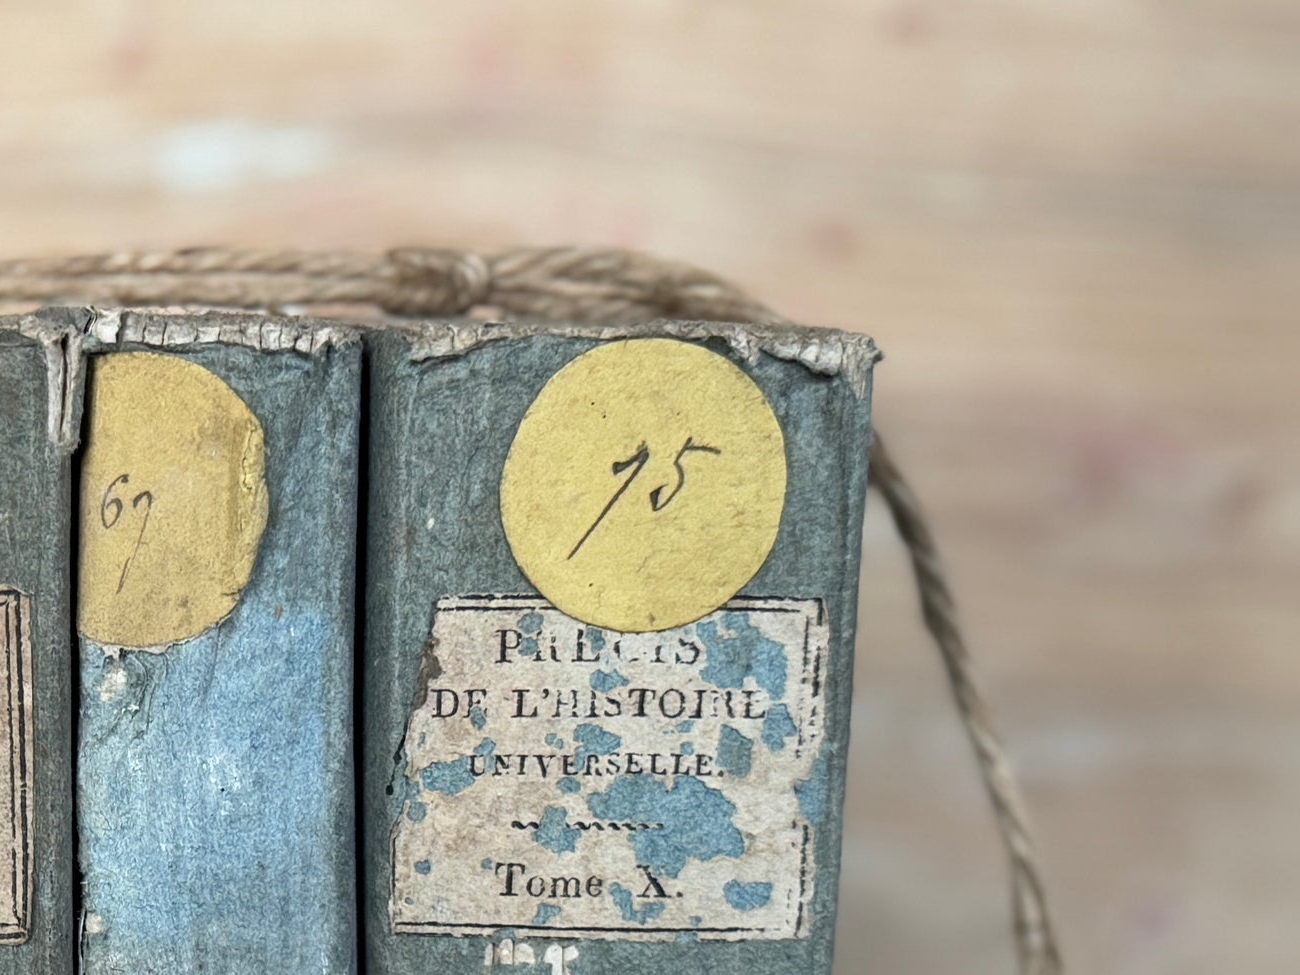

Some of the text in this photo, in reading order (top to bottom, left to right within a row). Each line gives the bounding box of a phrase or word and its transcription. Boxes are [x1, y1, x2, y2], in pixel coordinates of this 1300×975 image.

[567, 436, 721, 561] 75
[430, 688, 488, 720] DE
[495, 863, 683, 898] Tome X.
